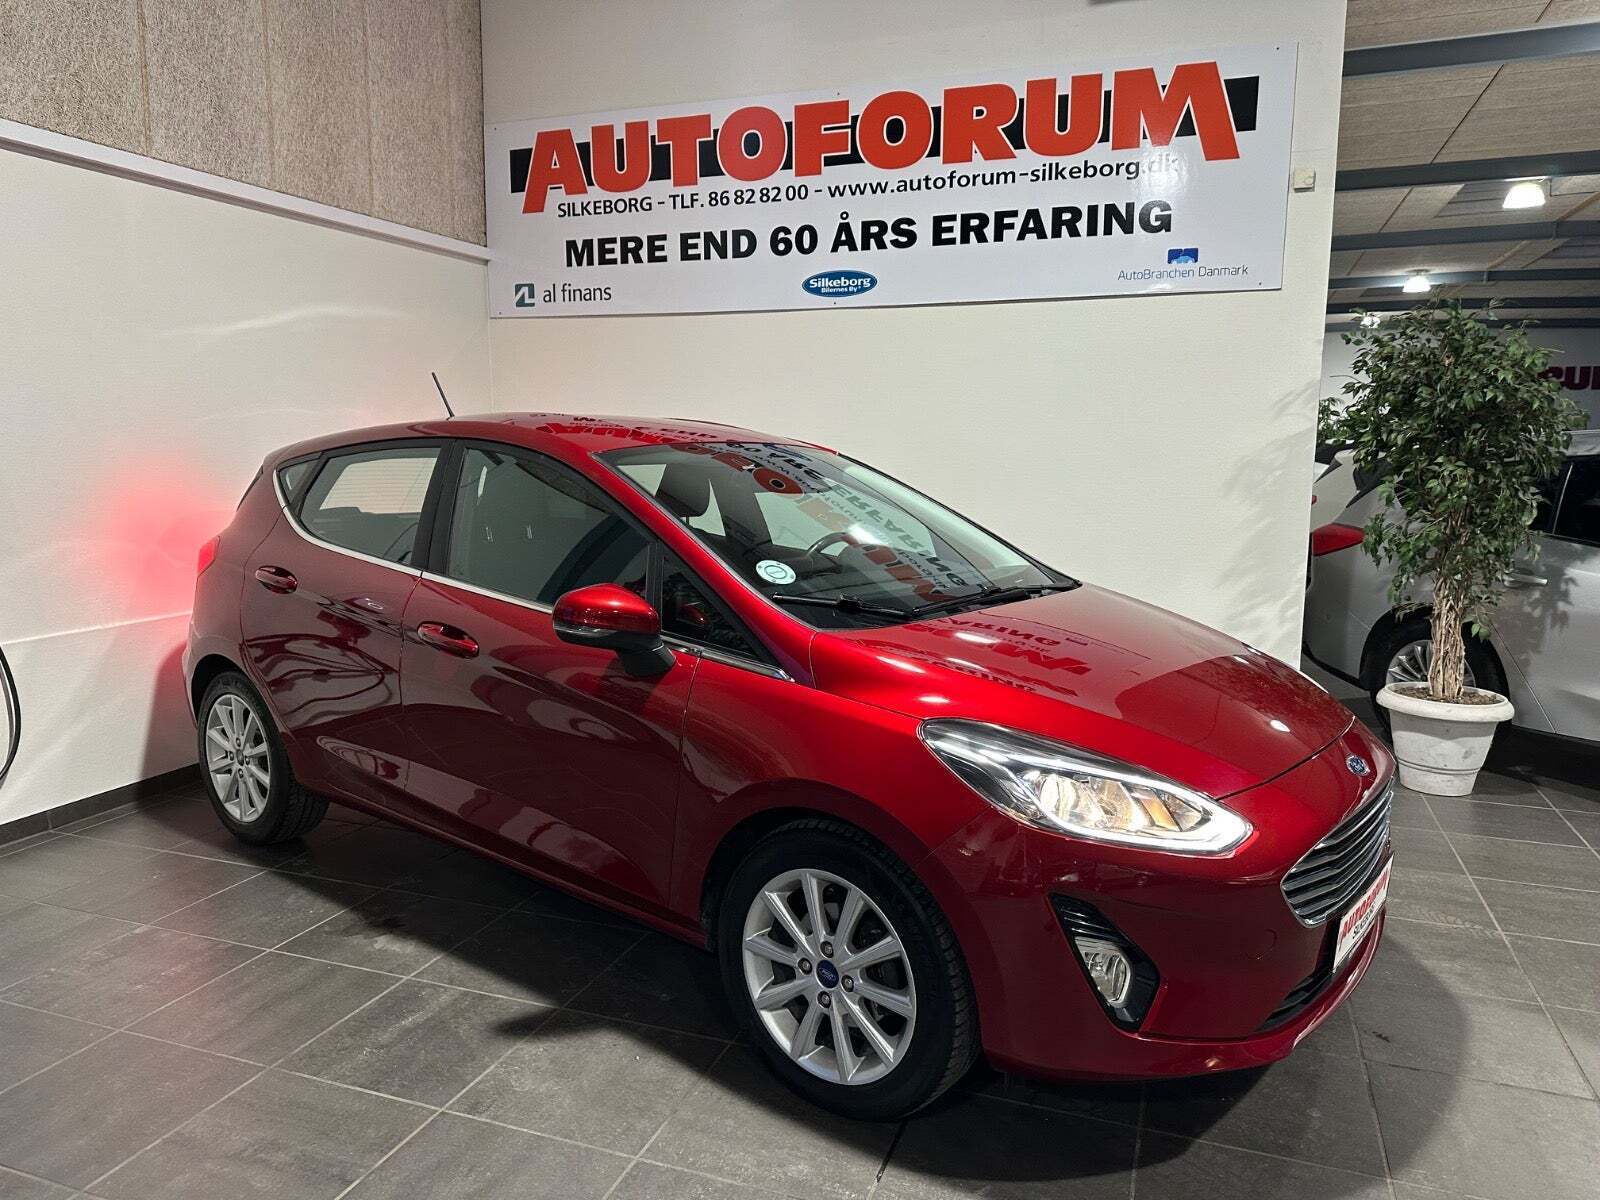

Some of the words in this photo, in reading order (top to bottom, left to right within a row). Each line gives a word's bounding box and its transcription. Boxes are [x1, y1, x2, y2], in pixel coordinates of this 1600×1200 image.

[522, 61, 1241, 213] AUTOFORUM
[557, 196, 653, 218] SILKEBORG
[668, 193, 705, 210] TLF.
[708, 191, 730, 207] 86
[733, 188, 756, 206] 82
[759, 186, 782, 204] 82
[785, 184, 809, 202] 00
[565, 233, 668, 268] MERE
[679, 228, 758, 262] END
[769, 224, 819, 257] 60
[830, 210, 918, 254] ÅRS
[931, 200, 1173, 247] ERFARING
[809, 276, 872, 288] Silkeborg
[1117, 266, 1195, 281] AutoBranchen
[1198, 264, 1249, 279] Danmark
[542, 283, 557, 304] al
[560, 282, 612, 303] finans
